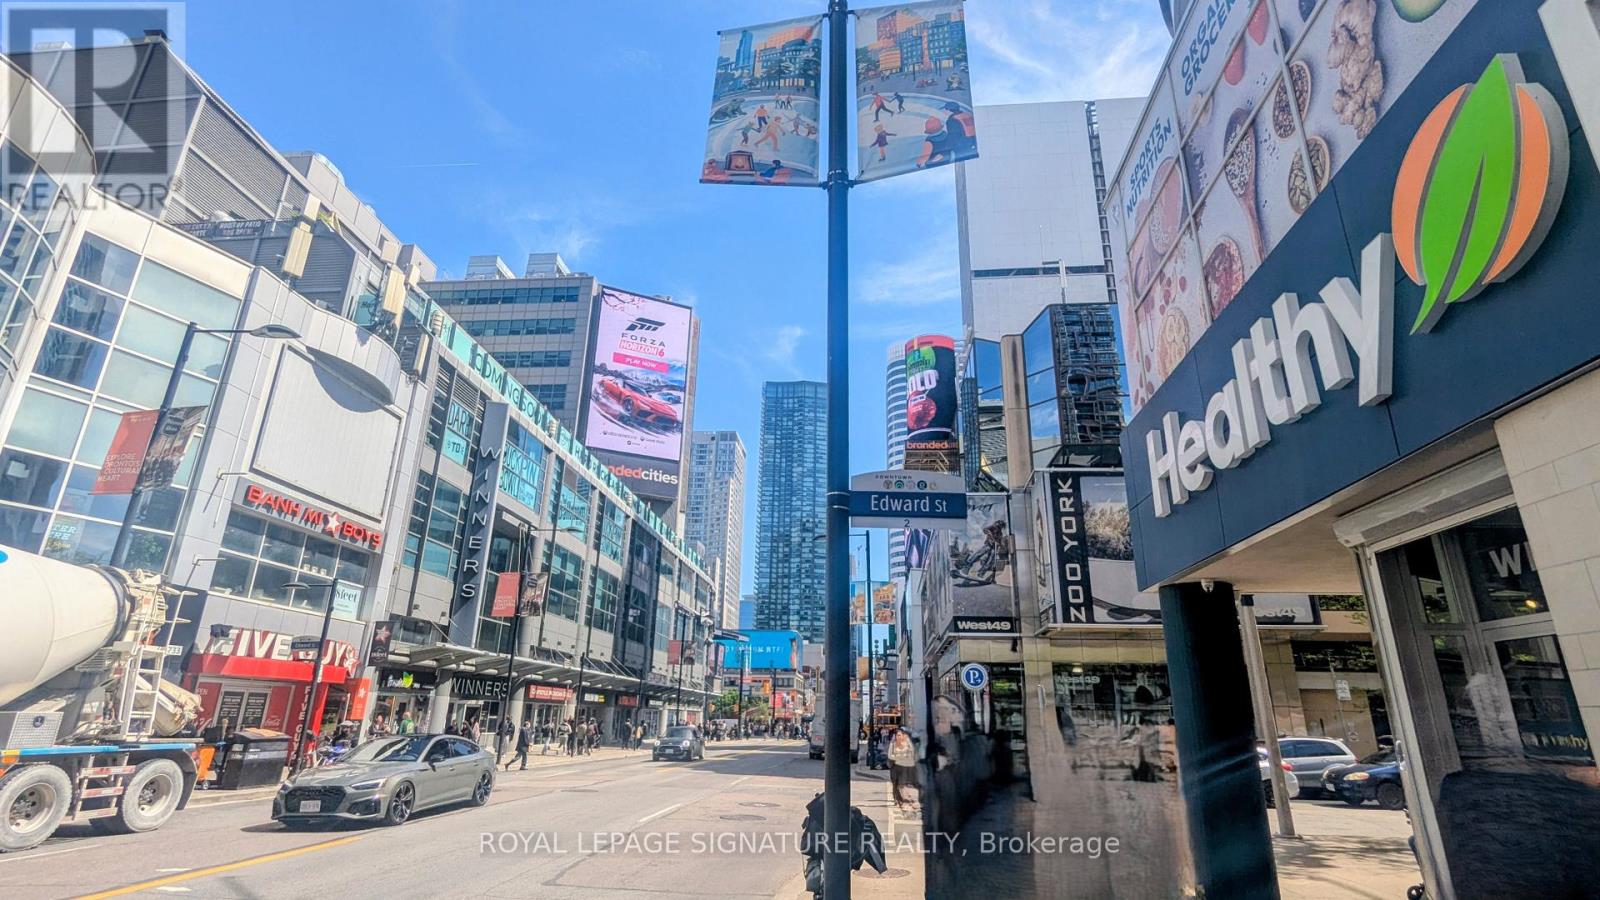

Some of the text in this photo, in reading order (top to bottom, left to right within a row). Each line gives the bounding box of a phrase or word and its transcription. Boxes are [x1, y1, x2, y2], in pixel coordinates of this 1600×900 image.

[1181, 0, 1219, 79] ORGA
[1126, 117, 1172, 218] NUTRITION
[1130, 117, 1161, 191] SPORTS
[619, 340, 665, 357] HORIZON 6
[621, 332, 666, 347] FORZA
[1146, 232, 1395, 518] Healthy
[247, 483, 383, 547] BANH MI BOYS
[871, 495, 947, 513] Edward St
[461, 447, 501, 597] WINNERS
[904, 519, 910, 527] 2
[1057, 477, 1087, 623] ZOO YORK
[957, 620, 1011, 631] West49
[450, 677, 508, 698] WINNERS
[968, 669, 978, 684] P
[298, 686, 311, 720] FIVE
